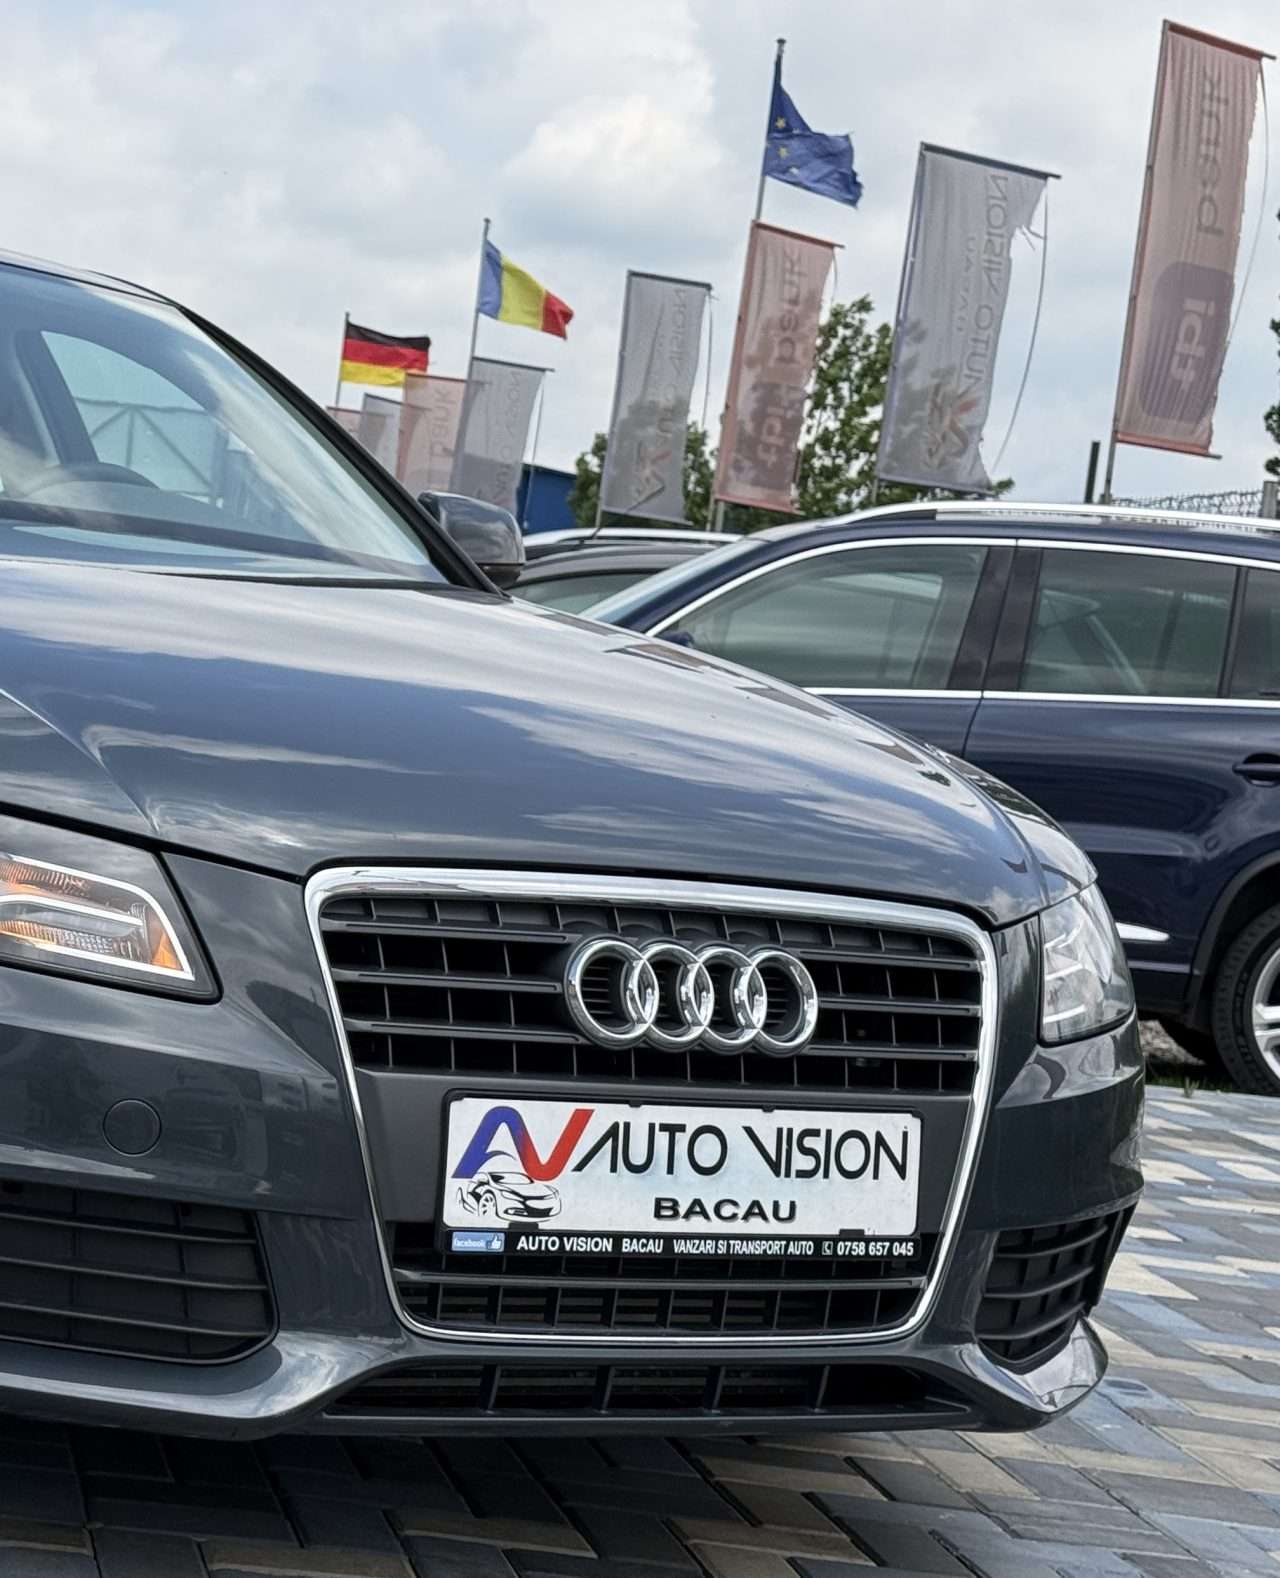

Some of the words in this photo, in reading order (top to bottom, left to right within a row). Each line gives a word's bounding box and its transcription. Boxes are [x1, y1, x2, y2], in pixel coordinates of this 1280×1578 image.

[571, 1121, 728, 1176] AUTO
[742, 1125, 908, 1181] VISION
[653, 1197, 797, 1222] BACAU
[517, 1236, 560, 1250] AUTO
[563, 1237, 613, 1251] VISION
[622, 1238, 663, 1253] BACAU
[673, 1239, 716, 1254] VANZARI
[717, 1240, 727, 1254] SI
[729, 1240, 787, 1255] TRANSPORT
[787, 1241, 814, 1255] AUTO
[837, 1241, 866, 1256] 0758
[868, 1242, 890, 1256] 657
[892, 1242, 914, 1256] 045
